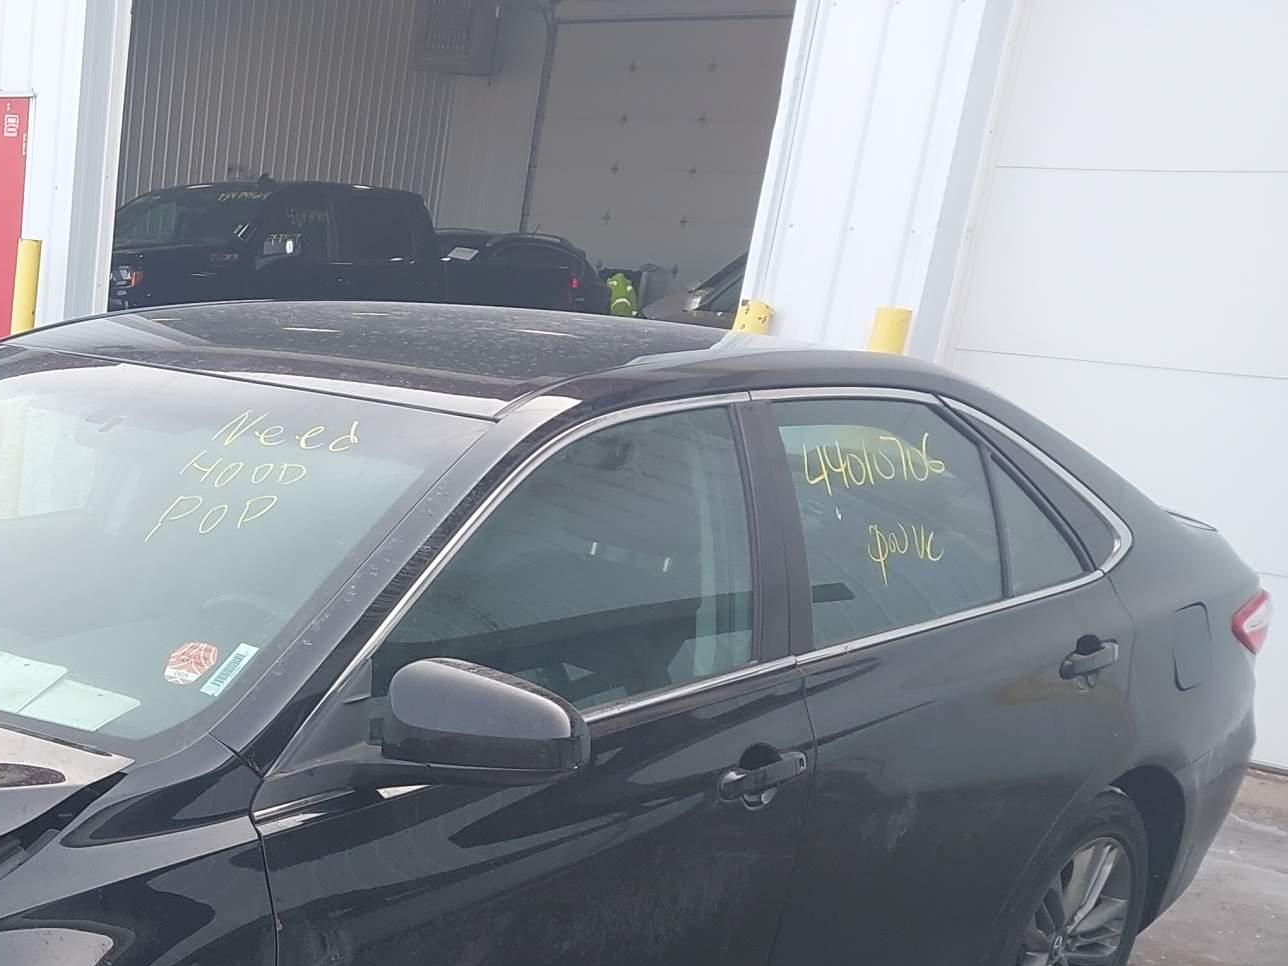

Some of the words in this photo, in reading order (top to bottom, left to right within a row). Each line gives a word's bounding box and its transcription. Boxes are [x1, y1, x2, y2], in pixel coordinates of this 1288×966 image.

[211, 409, 360, 451] Need
[179, 449, 307, 488] HOOD
[802, 432, 946, 496] 44010706
[144, 494, 279, 543] POP
